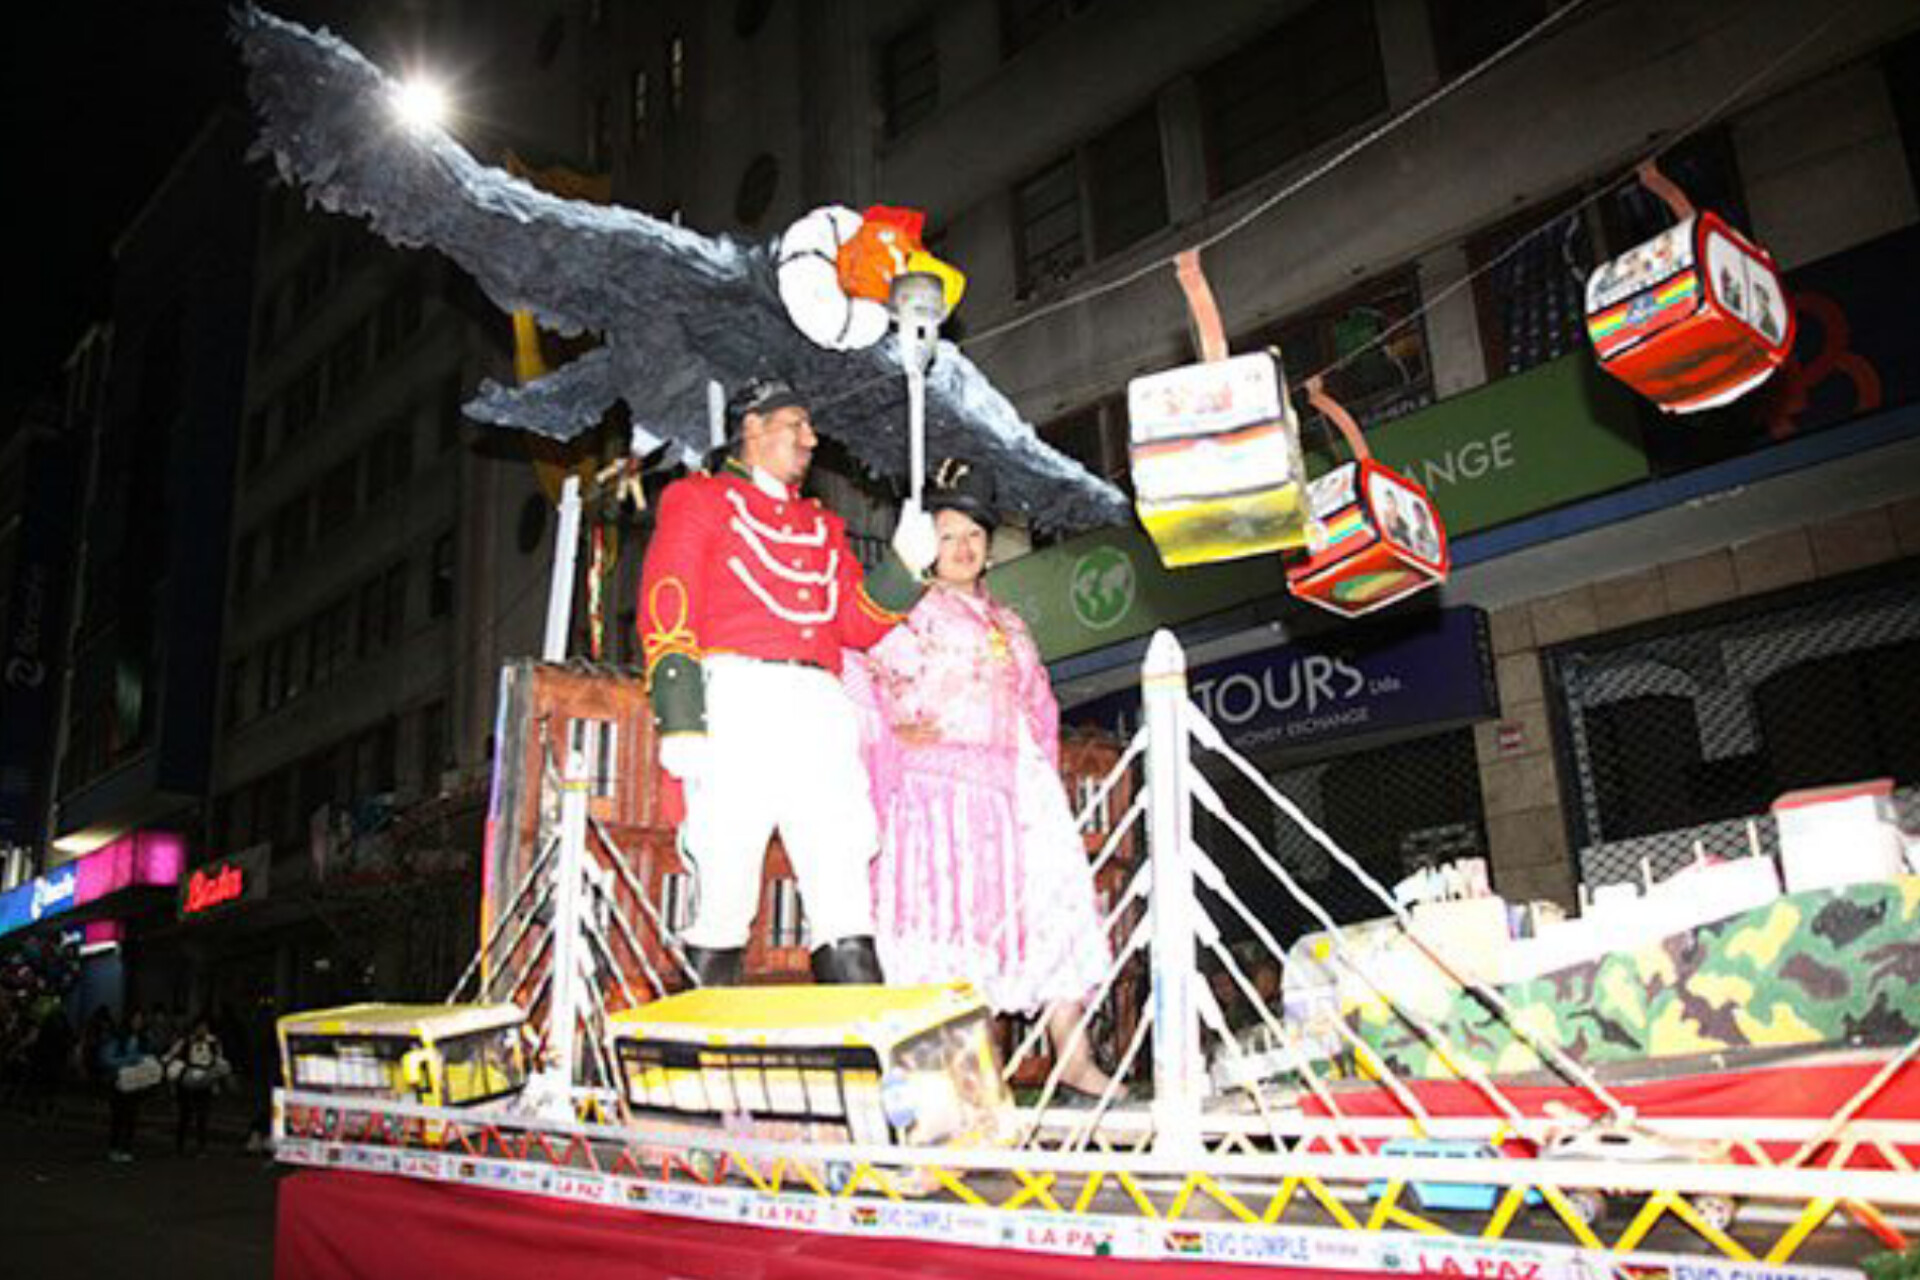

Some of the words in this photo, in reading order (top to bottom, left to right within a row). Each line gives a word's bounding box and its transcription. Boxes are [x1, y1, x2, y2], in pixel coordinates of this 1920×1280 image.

[1192, 655, 1364, 723] TOURS
[757, 1204, 778, 1221] LA
[784, 1206, 818, 1226] PAZ
[1026, 1227, 1058, 1246] LA
